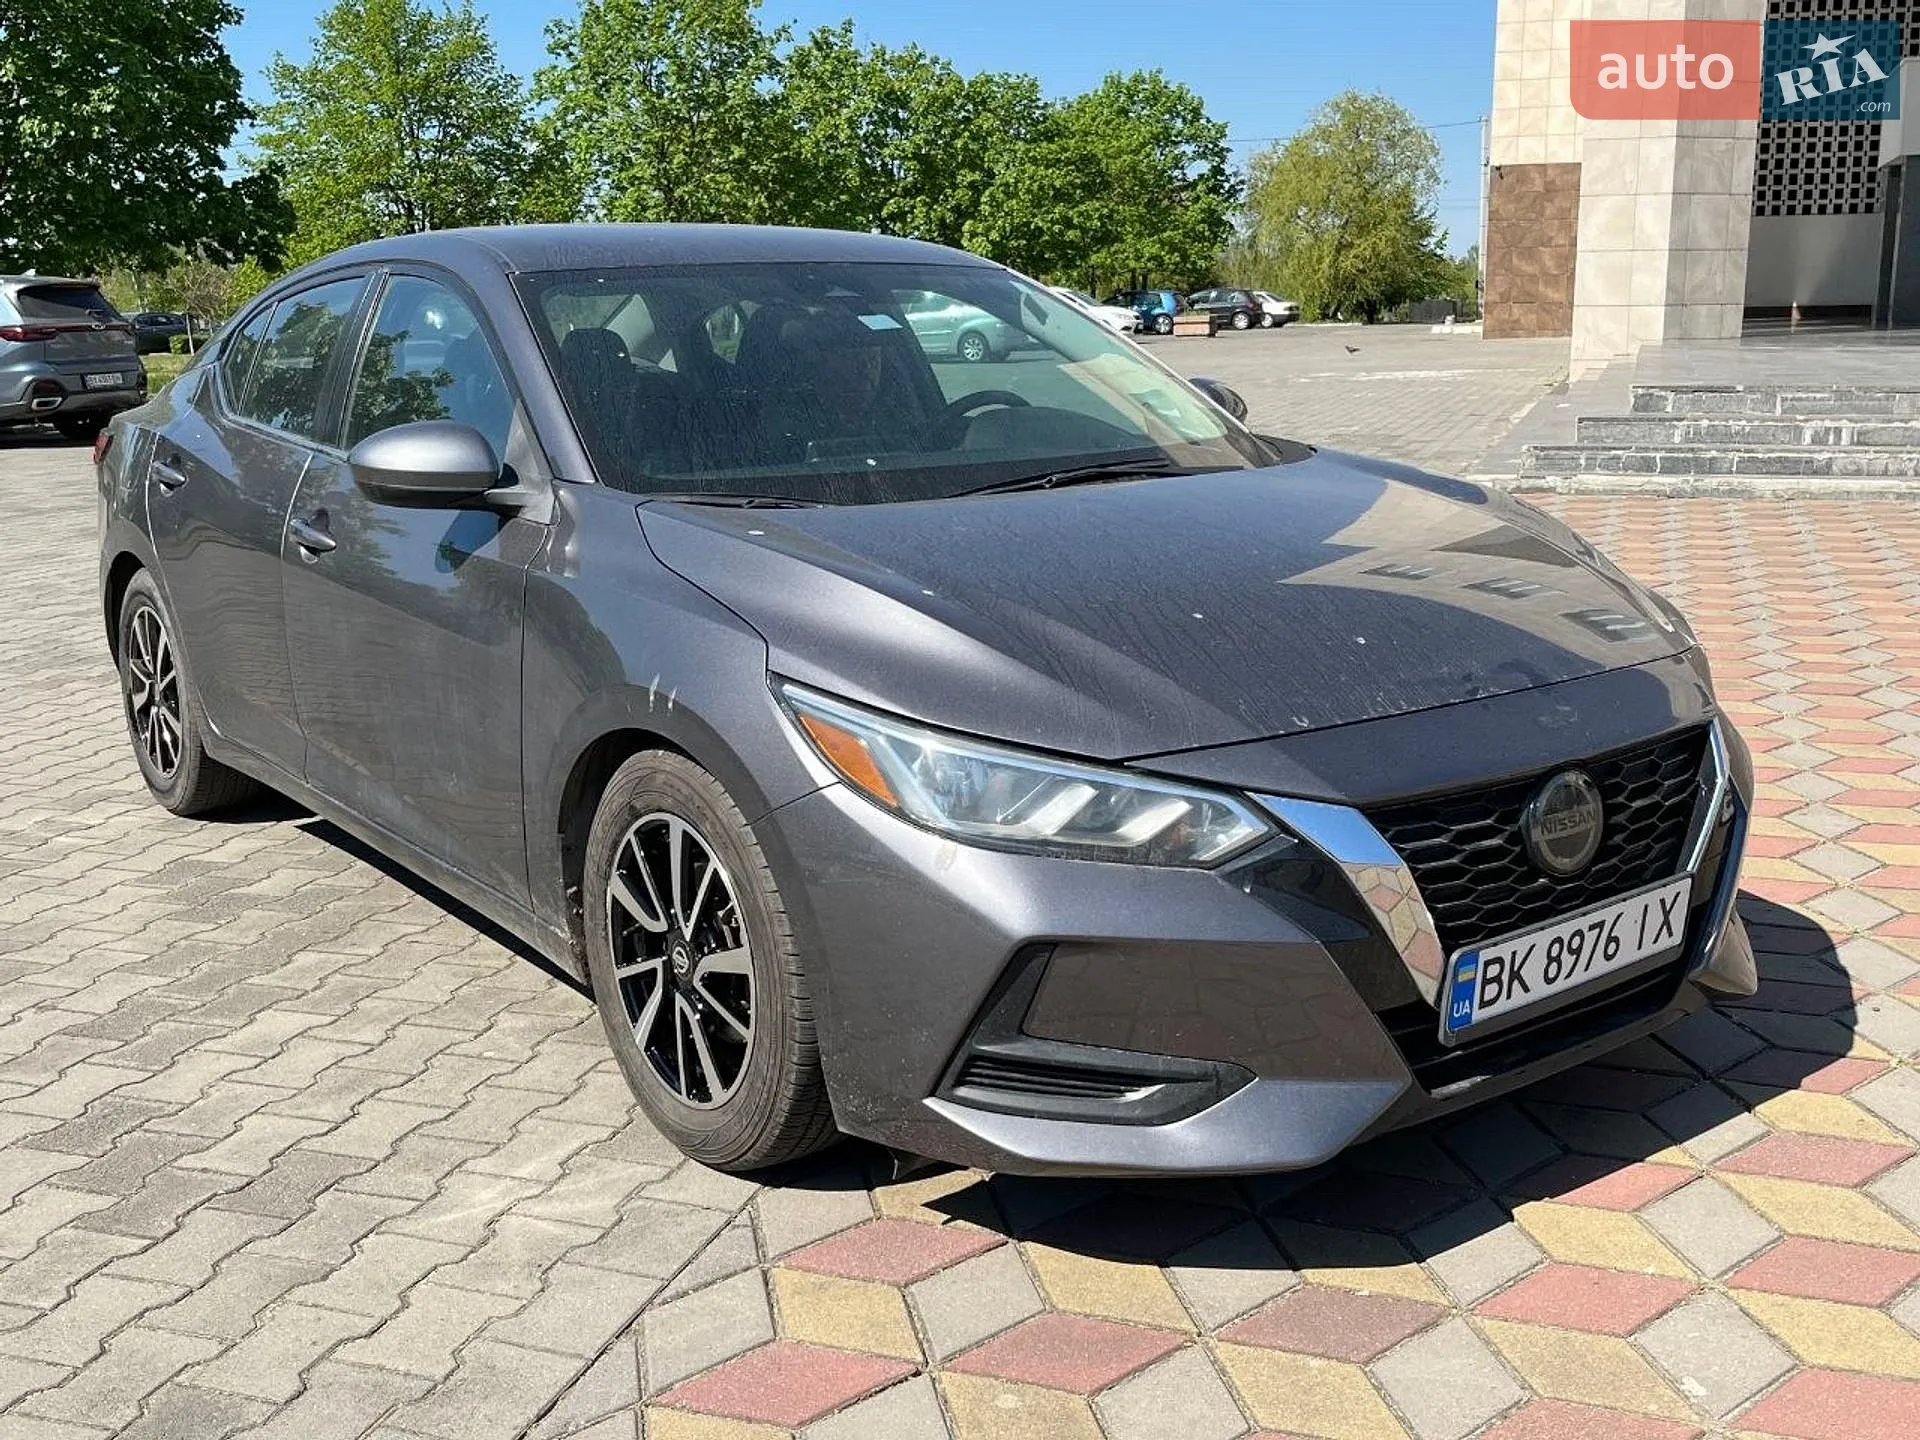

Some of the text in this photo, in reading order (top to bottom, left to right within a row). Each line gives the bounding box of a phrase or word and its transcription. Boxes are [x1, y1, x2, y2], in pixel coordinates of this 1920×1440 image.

[1540, 808, 1596, 836] NISSAN
[1478, 891, 1681, 1010] BK 8976 IX
[1453, 999, 1471, 1018] UA
